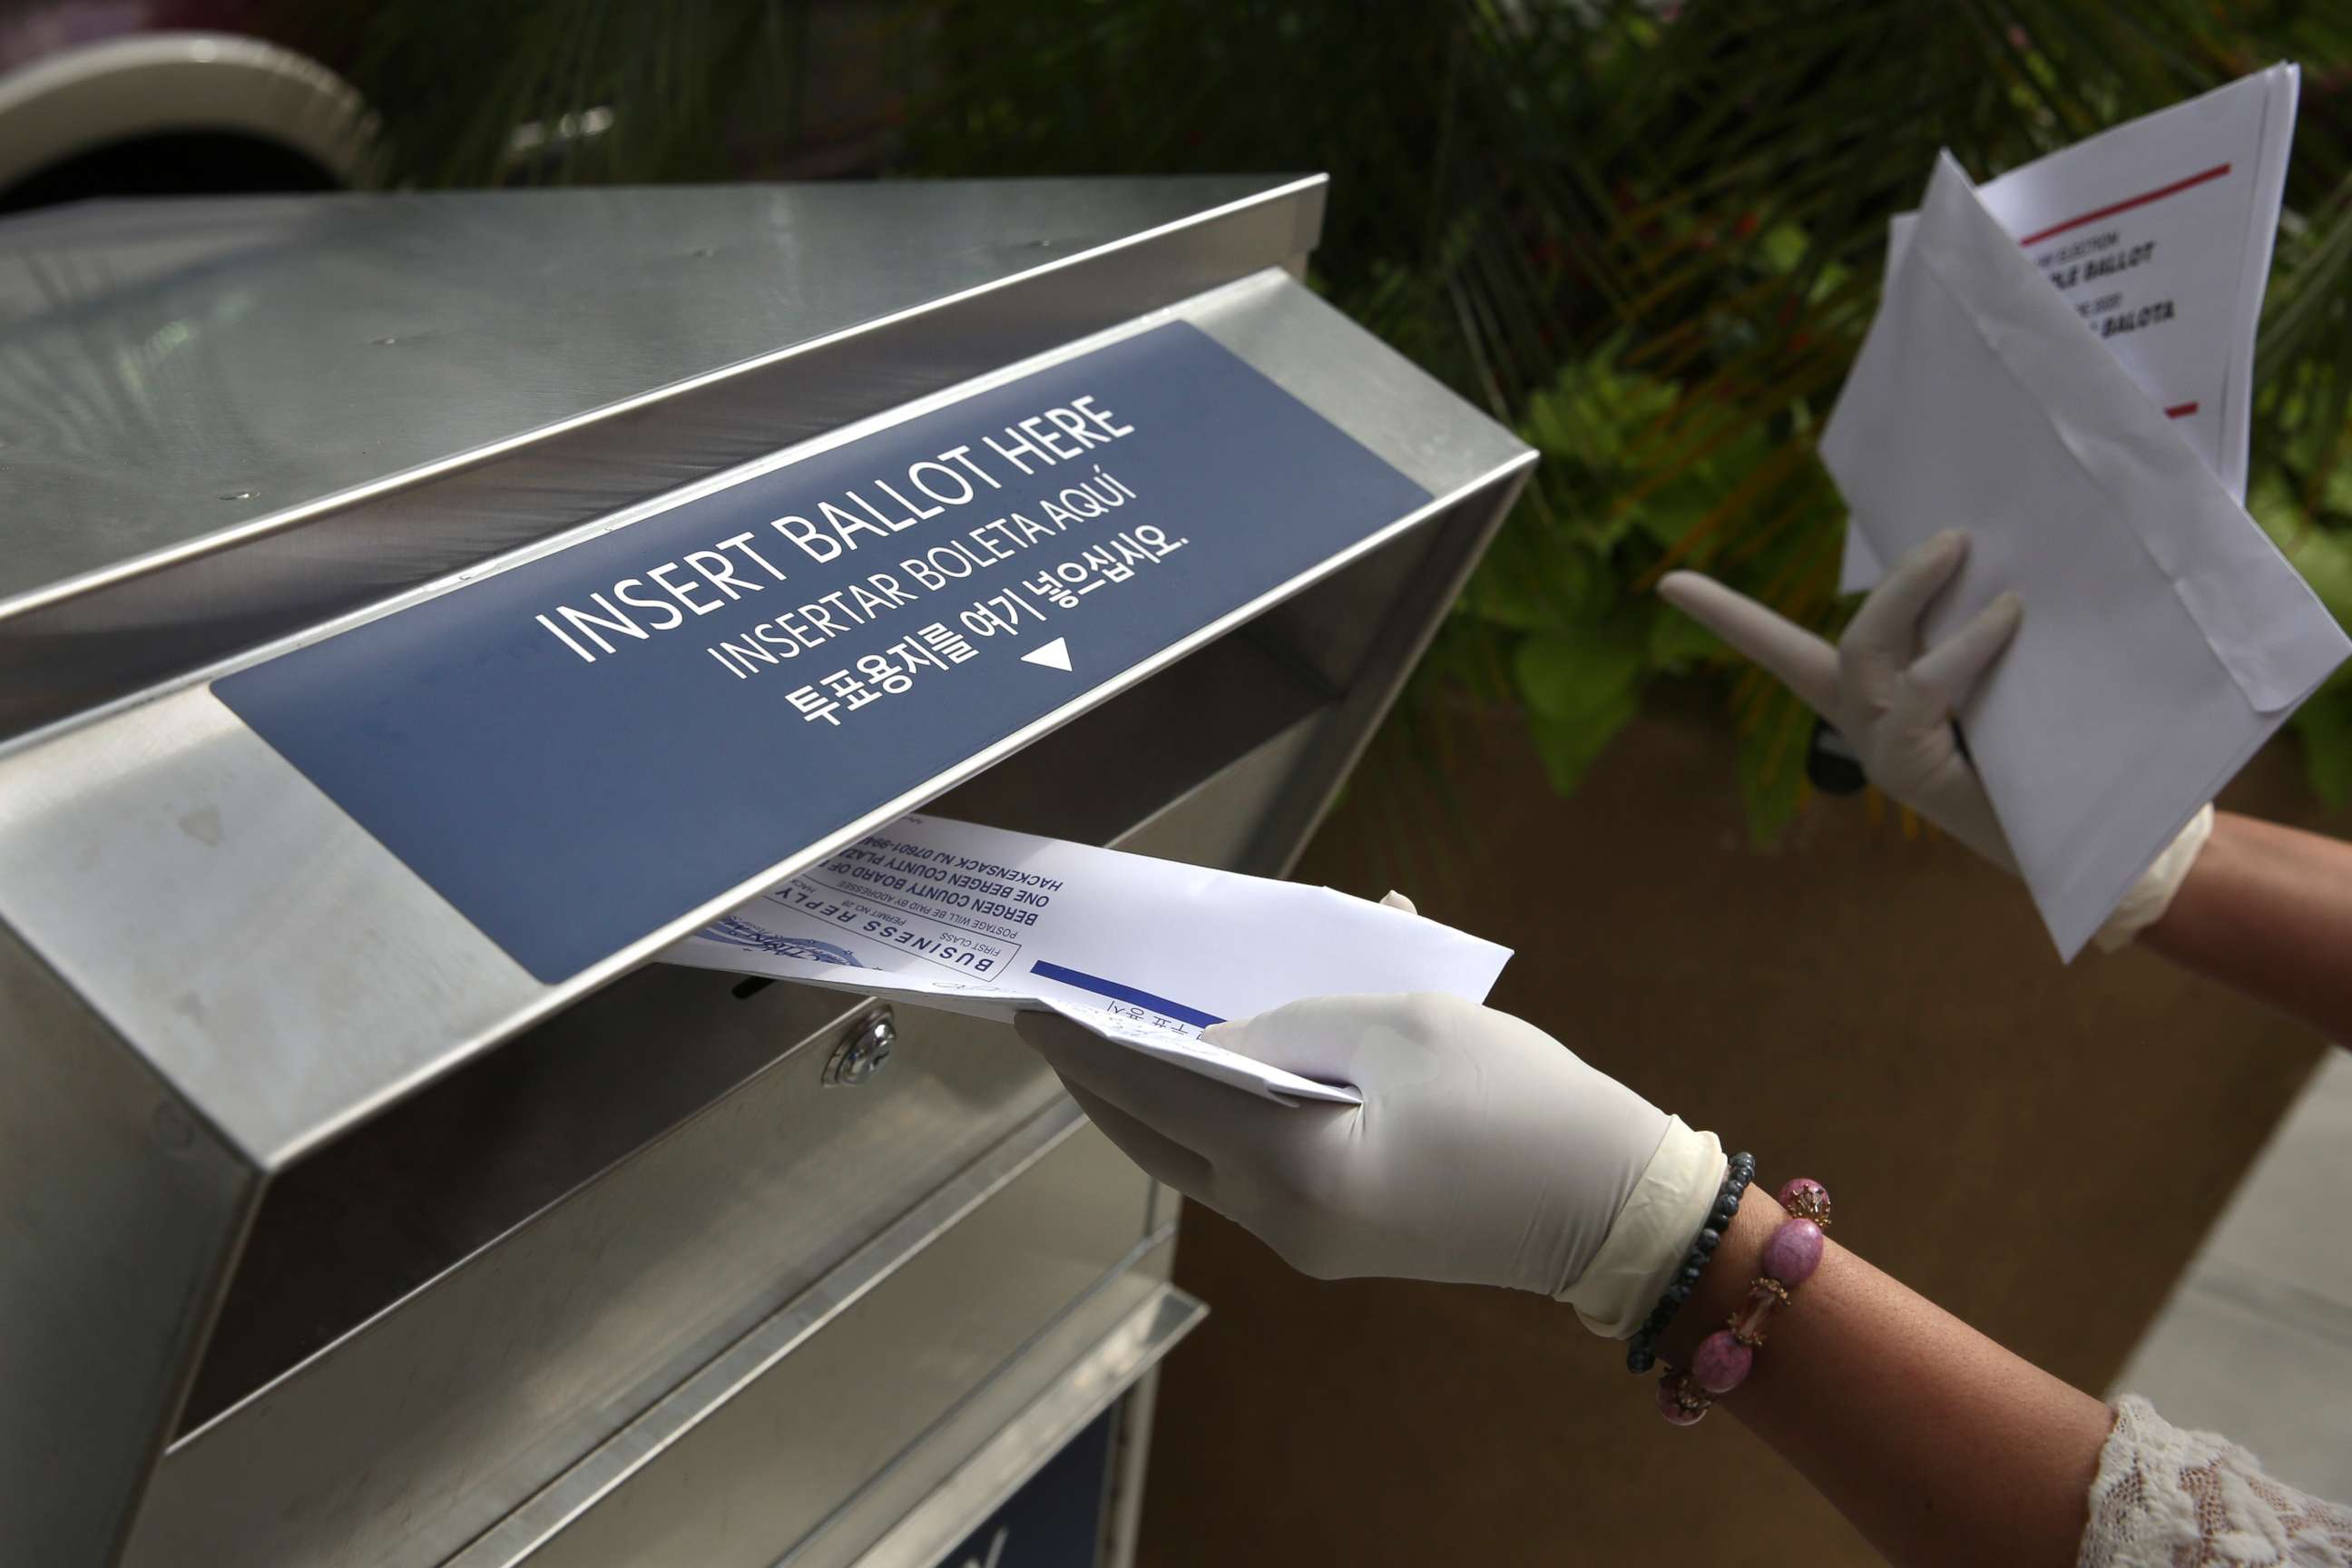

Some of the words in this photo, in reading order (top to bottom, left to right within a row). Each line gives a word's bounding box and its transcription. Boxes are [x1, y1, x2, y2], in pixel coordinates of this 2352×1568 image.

[2083, 240, 2156, 283] BALLOT
[2101, 299, 2175, 339] BALOTA
[535, 531, 787, 664] INSERT
[770, 445, 1002, 564] BALLOT
[983, 395, 1135, 476] HERE
[707, 573, 918, 680] INSERTAR
[900, 512, 1053, 592] BOLETA
[1039, 464, 1137, 521] AQUÍ
[785, 622, 980, 726] 투표용지를
[959, 587, 1047, 638] 여기
[1023, 523, 1189, 610] 넣으십시오.
[827, 863, 851, 874] OF
[885, 858, 947, 881] COUNTY
[933, 851, 956, 865] NJ
[852, 867, 907, 890] BOARD
[947, 873, 1014, 898] BERGEN
[954, 857, 1063, 892] HACKENSACK
[837, 880, 896, 902] ADDRESSEE
[895, 897, 908, 908] BY
[906, 882, 970, 907] COUNTY
[1014, 889, 1050, 908] ONE
[775, 887, 857, 923] REPLY
[907, 901, 931, 915] PAID
[933, 908, 947, 919] BE
[971, 898, 1039, 926] BERGEN
[868, 908, 907, 926] PERMIT
[950, 913, 971, 926] WILL
[939, 932, 972, 949] CLASS
[972, 919, 1019, 939] POSTAGE
[863, 920, 995, 972] BUSINESS
[971, 942, 1002, 957] FIRST
